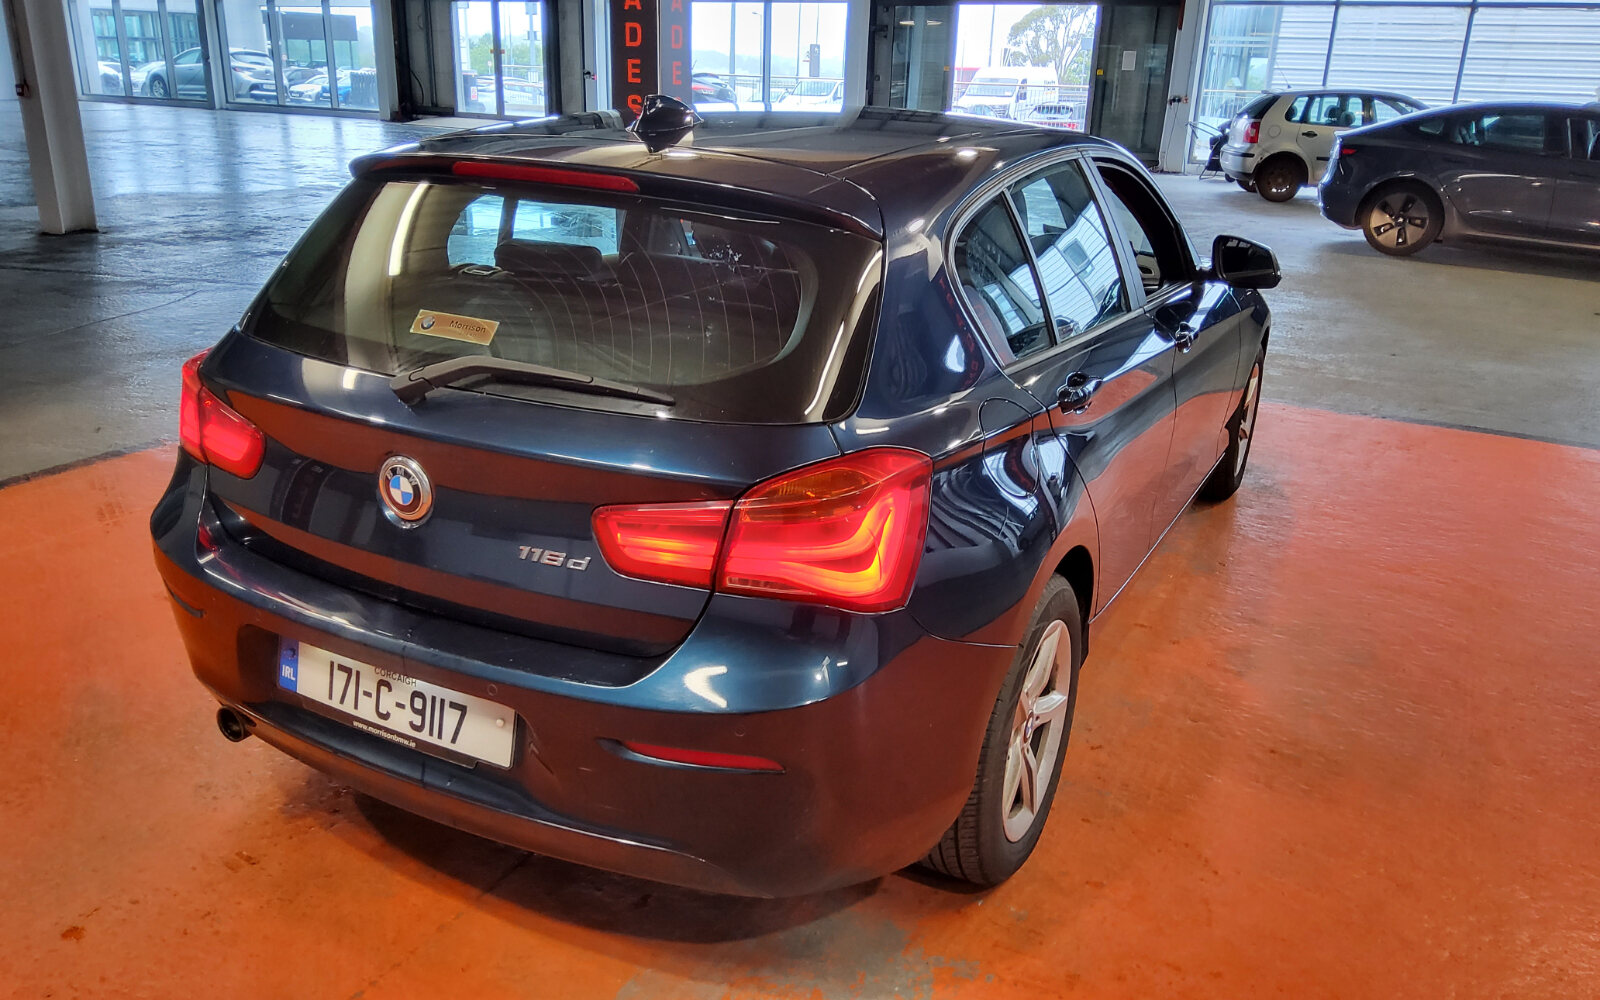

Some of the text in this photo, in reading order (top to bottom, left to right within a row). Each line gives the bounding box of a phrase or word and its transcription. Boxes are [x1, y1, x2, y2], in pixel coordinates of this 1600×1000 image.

[449, 320, 486, 333] Morrison
[386, 466, 418, 486] BMW
[281, 664, 296, 681] IRL
[374, 666, 417, 687] CORCAIGH
[328, 660, 468, 745] 171-C-9117
[352, 720, 416, 748] www.morrisonbmw.ie
